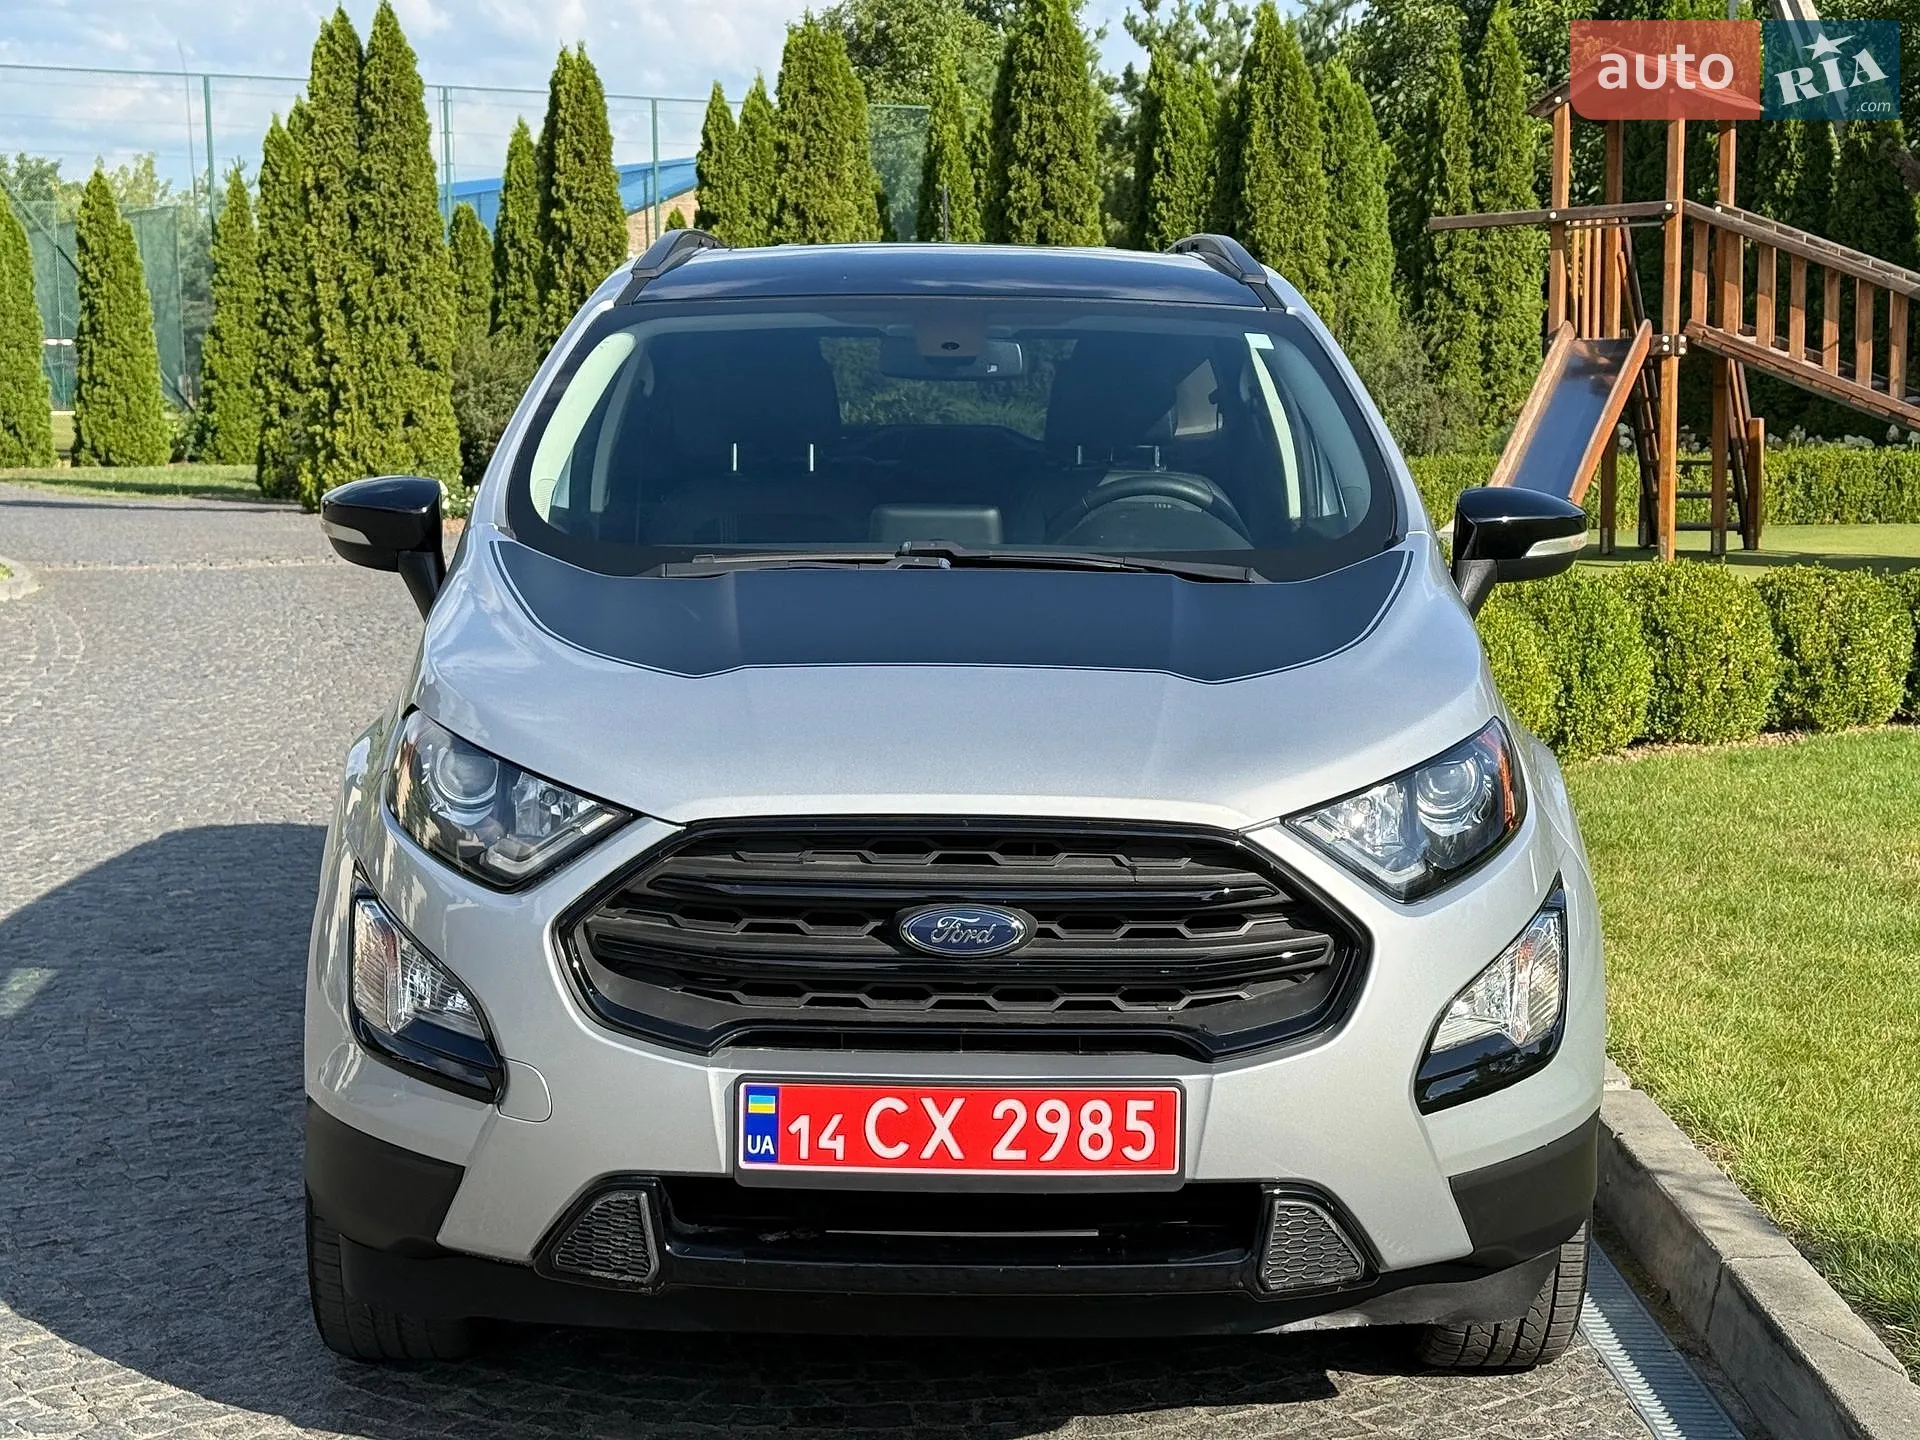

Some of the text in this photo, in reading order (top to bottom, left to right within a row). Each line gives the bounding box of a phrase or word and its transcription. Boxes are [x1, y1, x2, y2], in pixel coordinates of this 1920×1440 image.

[930, 916, 997, 944] Ford
[787, 1096, 1155, 1162] 14 CX 2985
[747, 1134, 775, 1155] UA
